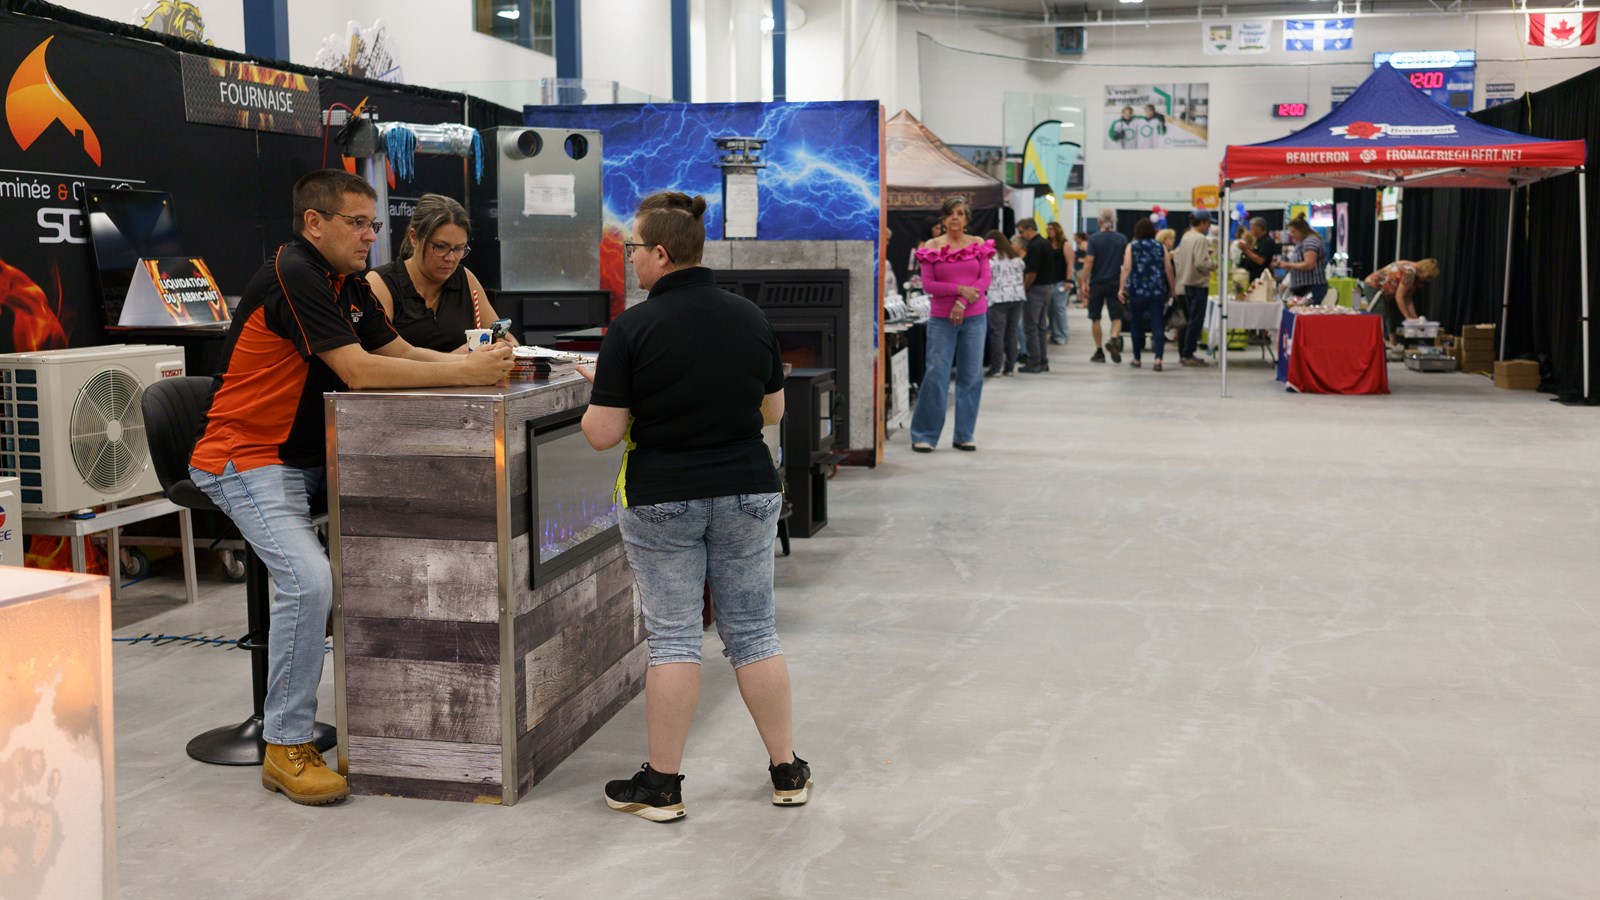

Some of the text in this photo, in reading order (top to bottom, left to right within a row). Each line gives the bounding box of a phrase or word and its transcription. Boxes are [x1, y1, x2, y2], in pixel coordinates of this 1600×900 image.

[220, 81, 294, 113] FOURNAISE
[1285, 151, 1350, 164] BEAUCERON
[57, 183, 69, 201] &
[160, 278, 209, 289] LIQUIDATION
[163, 291, 219, 304] DU FABRICANT
[161, 368, 183, 378] TOSOT
